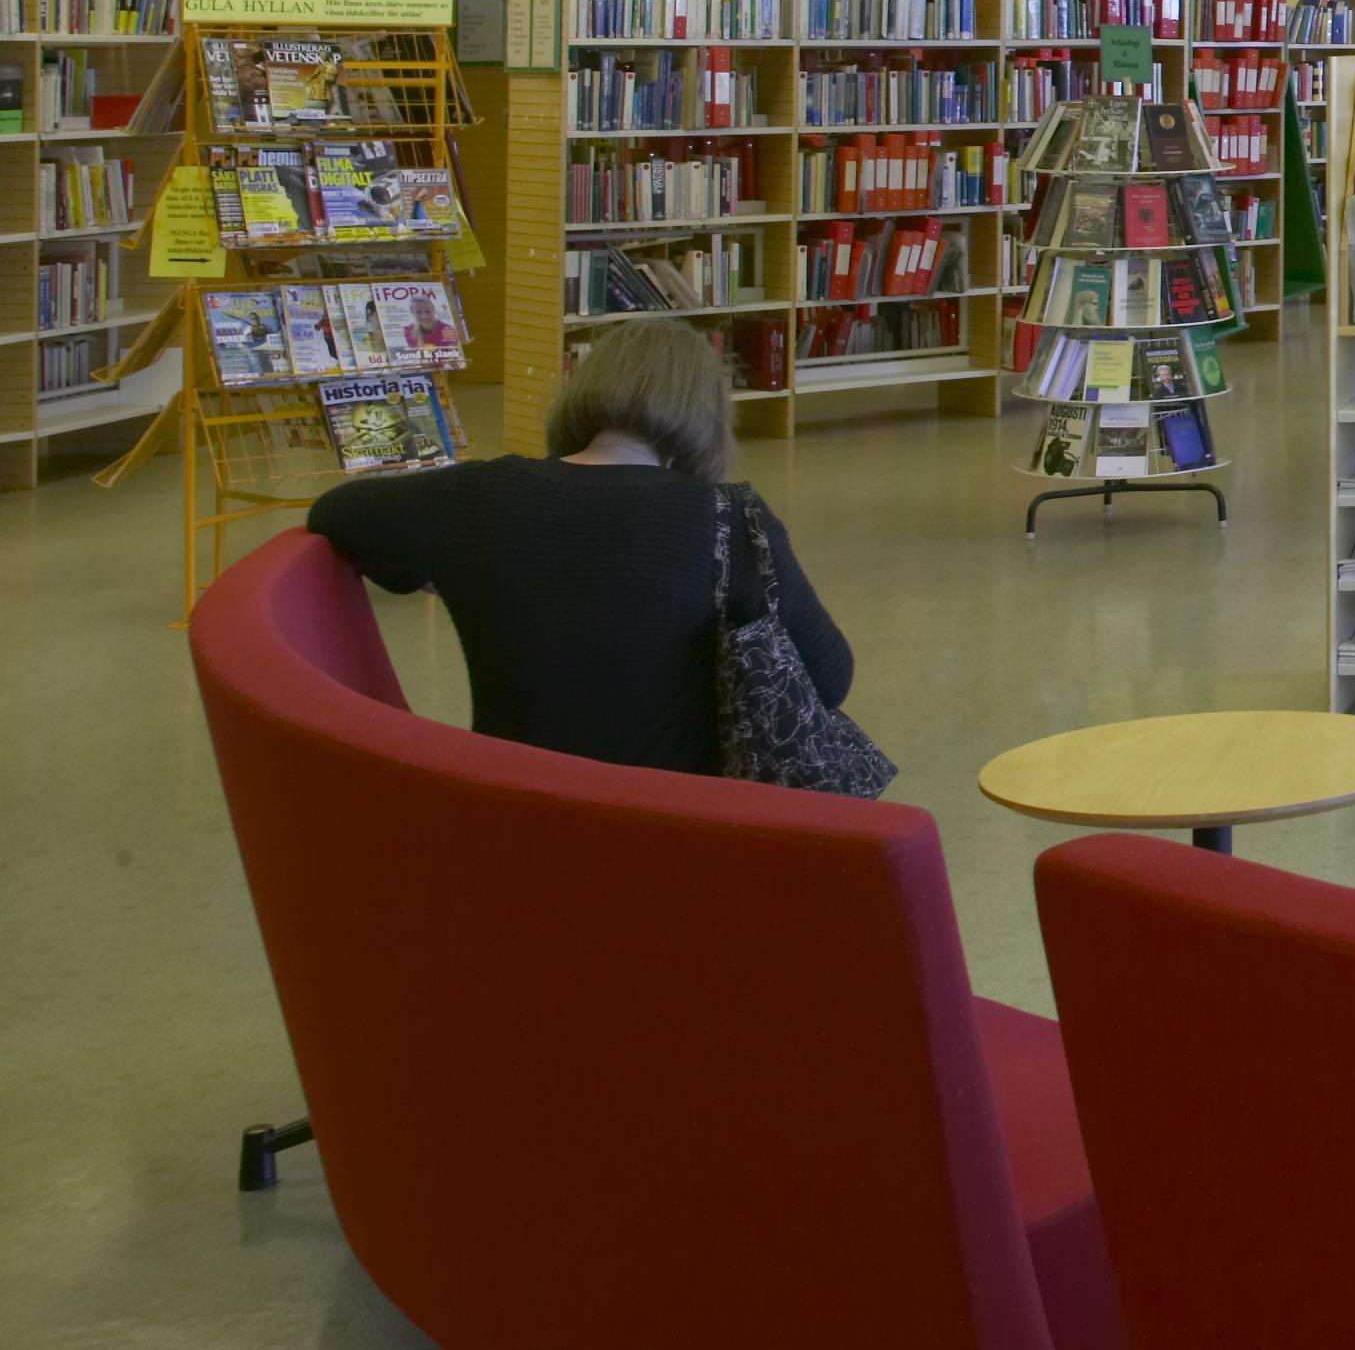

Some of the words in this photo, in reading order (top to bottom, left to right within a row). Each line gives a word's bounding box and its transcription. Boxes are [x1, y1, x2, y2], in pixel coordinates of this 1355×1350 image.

[244, 0, 315, 14] HYLLAN
[266, 51, 342, 65] VETENSKP
[318, 155, 354, 172] FILMA
[239, 169, 277, 184] PLATT
[320, 170, 374, 187] DIGITALT
[1050, 404, 1087, 421] AUGUSTI
